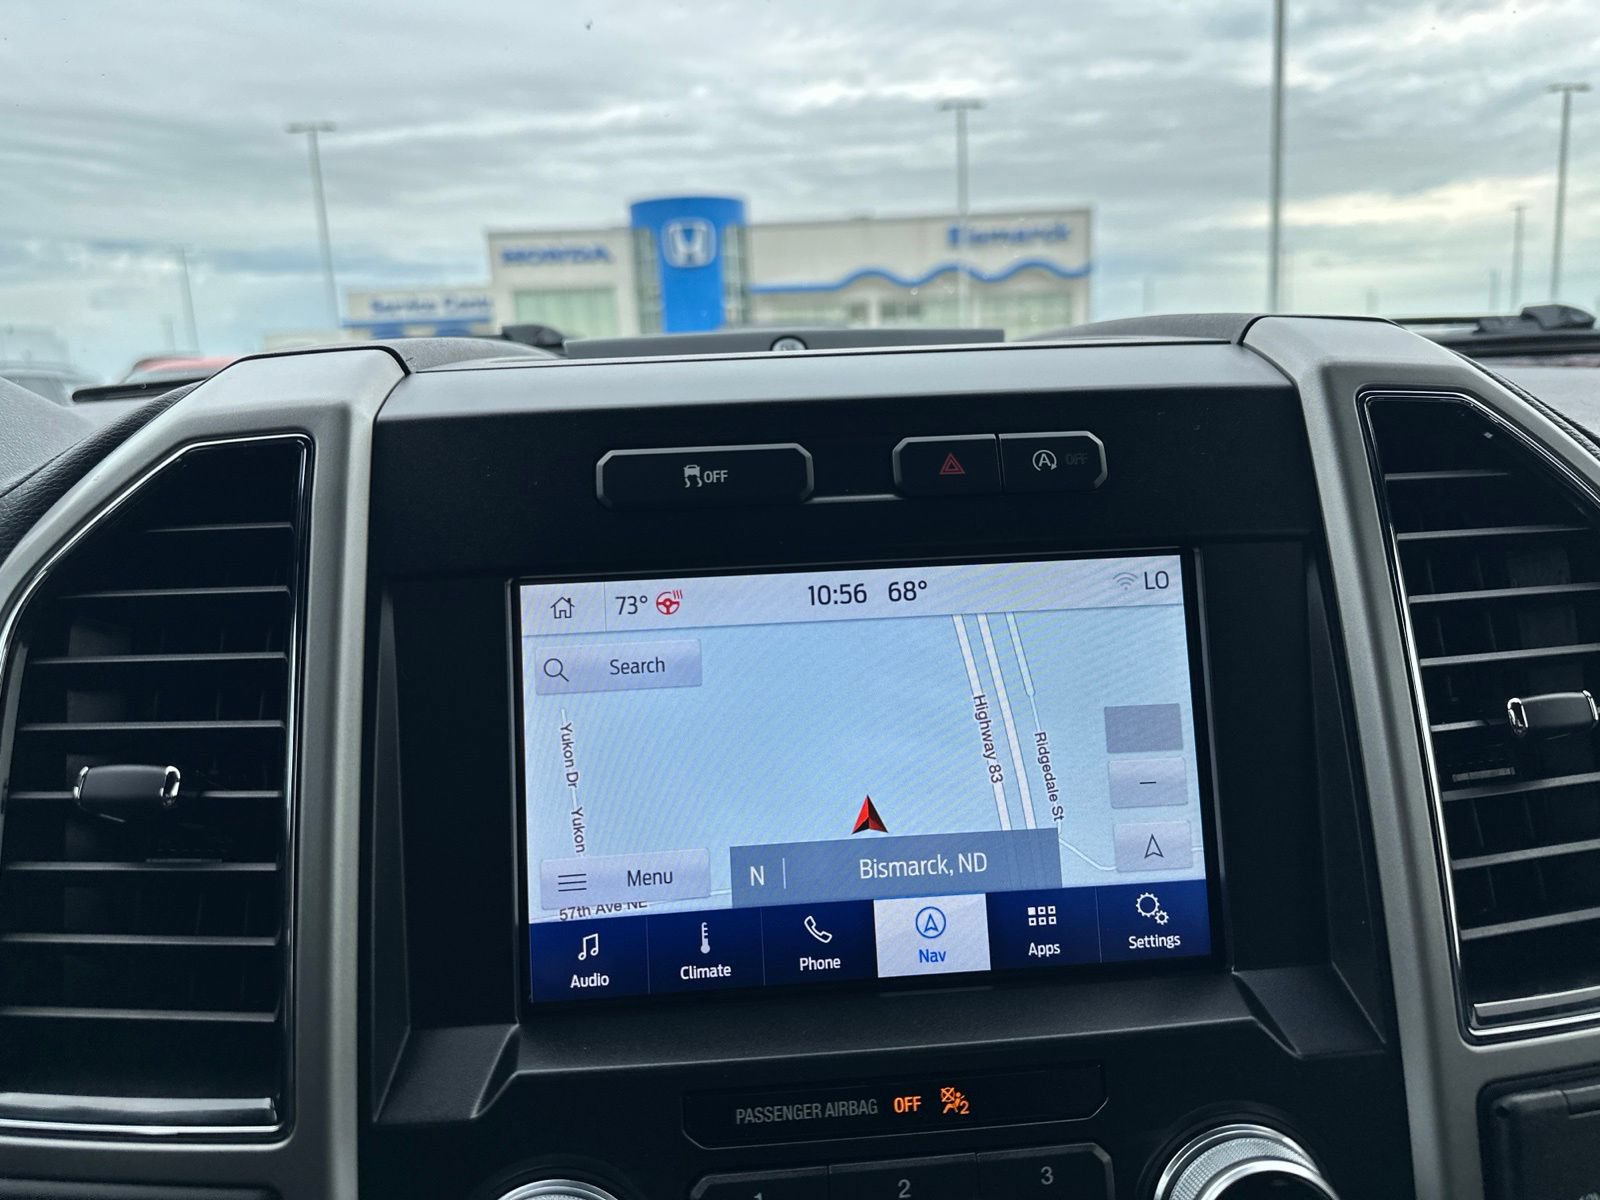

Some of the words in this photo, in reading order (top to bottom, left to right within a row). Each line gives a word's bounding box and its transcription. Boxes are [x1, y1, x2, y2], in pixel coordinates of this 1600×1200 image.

[501, 246, 610, 264] HONDA
[1065, 452, 1088, 465] OFF
[704, 468, 729, 485] OFF
[1144, 570, 1170, 590] LO
[807, 583, 868, 606] 10:56
[887, 580, 928, 603] 68°
[615, 595, 648, 616] 73°
[609, 656, 666, 676] Search
[560, 721, 575, 769] Yukon
[972, 694, 998, 762] Highway
[988, 764, 1005, 784] 83
[565, 770, 580, 789] Dr
[1034, 731, 1060, 802] Ridgedale
[1051, 804, 1066, 822] St
[570, 806, 586, 854] Yukon
[750, 865, 766, 887] N
[859, 855, 954, 882] Bismarck,
[958, 852, 988, 874] ND
[626, 867, 674, 888] Menu
[559, 904, 592, 922] 57th
[595, 902, 623, 916] Ave
[1028, 941, 1062, 958] Apps
[1128, 933, 1182, 951] Settings
[799, 955, 842, 972] Phone
[918, 948, 947, 964] Nav
[569, 971, 610, 990] Audio
[680, 963, 732, 982] Climate
[735, 1104, 822, 1124] PASSENGER
[824, 1098, 879, 1118] AIRBAG
[893, 1096, 922, 1114] OFF
[1040, 1166, 1055, 1186] 3
[897, 1179, 912, 1199] 2
